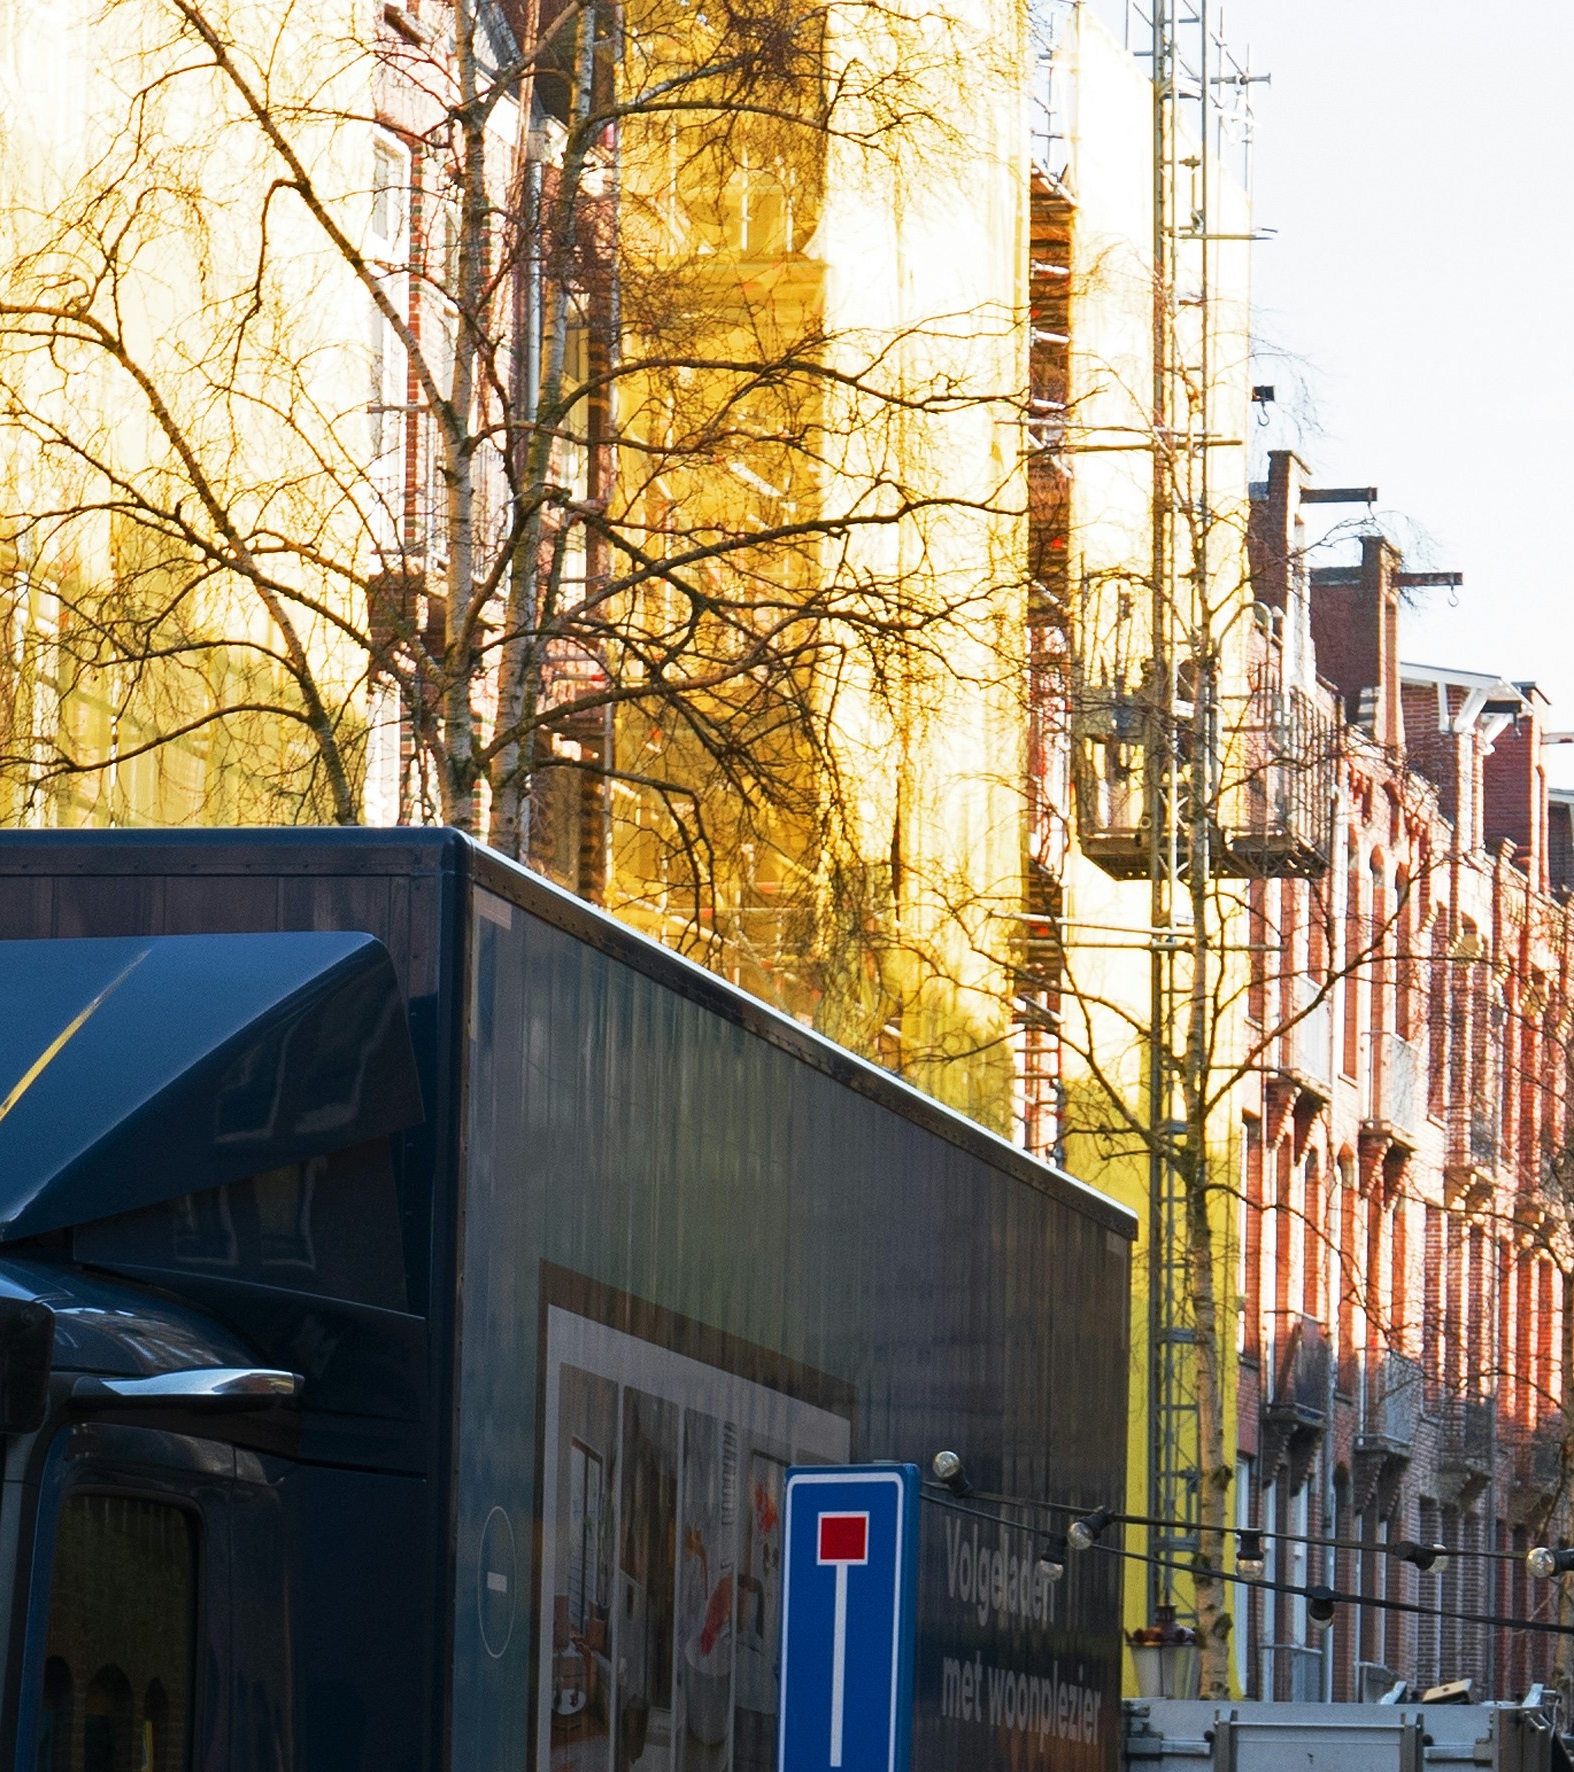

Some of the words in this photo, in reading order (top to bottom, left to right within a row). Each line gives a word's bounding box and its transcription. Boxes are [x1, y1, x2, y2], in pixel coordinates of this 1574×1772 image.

[945, 1515, 1057, 1627] Volgeladen
[942, 1650, 983, 1723] met
[987, 1660, 1103, 1752] woonplezier
